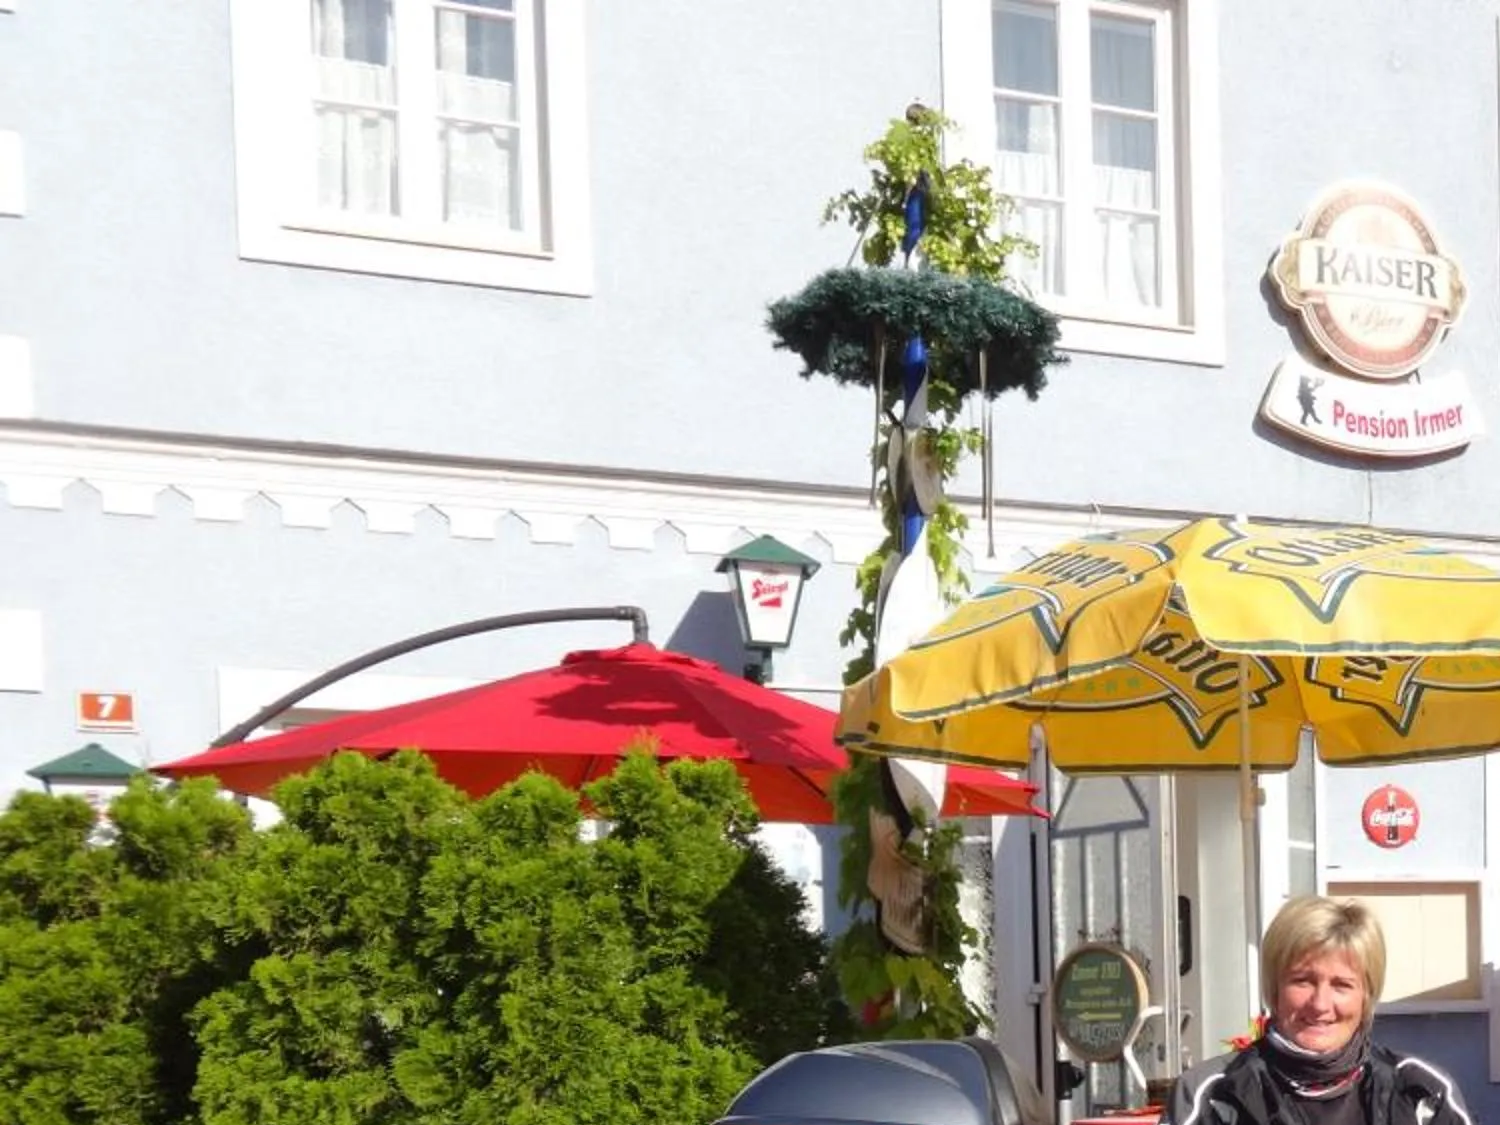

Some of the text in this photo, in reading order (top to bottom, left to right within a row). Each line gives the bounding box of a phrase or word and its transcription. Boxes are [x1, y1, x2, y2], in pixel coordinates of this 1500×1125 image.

[1314, 245, 1439, 300] KAISER
[1332, 400, 1464, 439] Pension Irmer
[96, 695, 118, 719] 7
